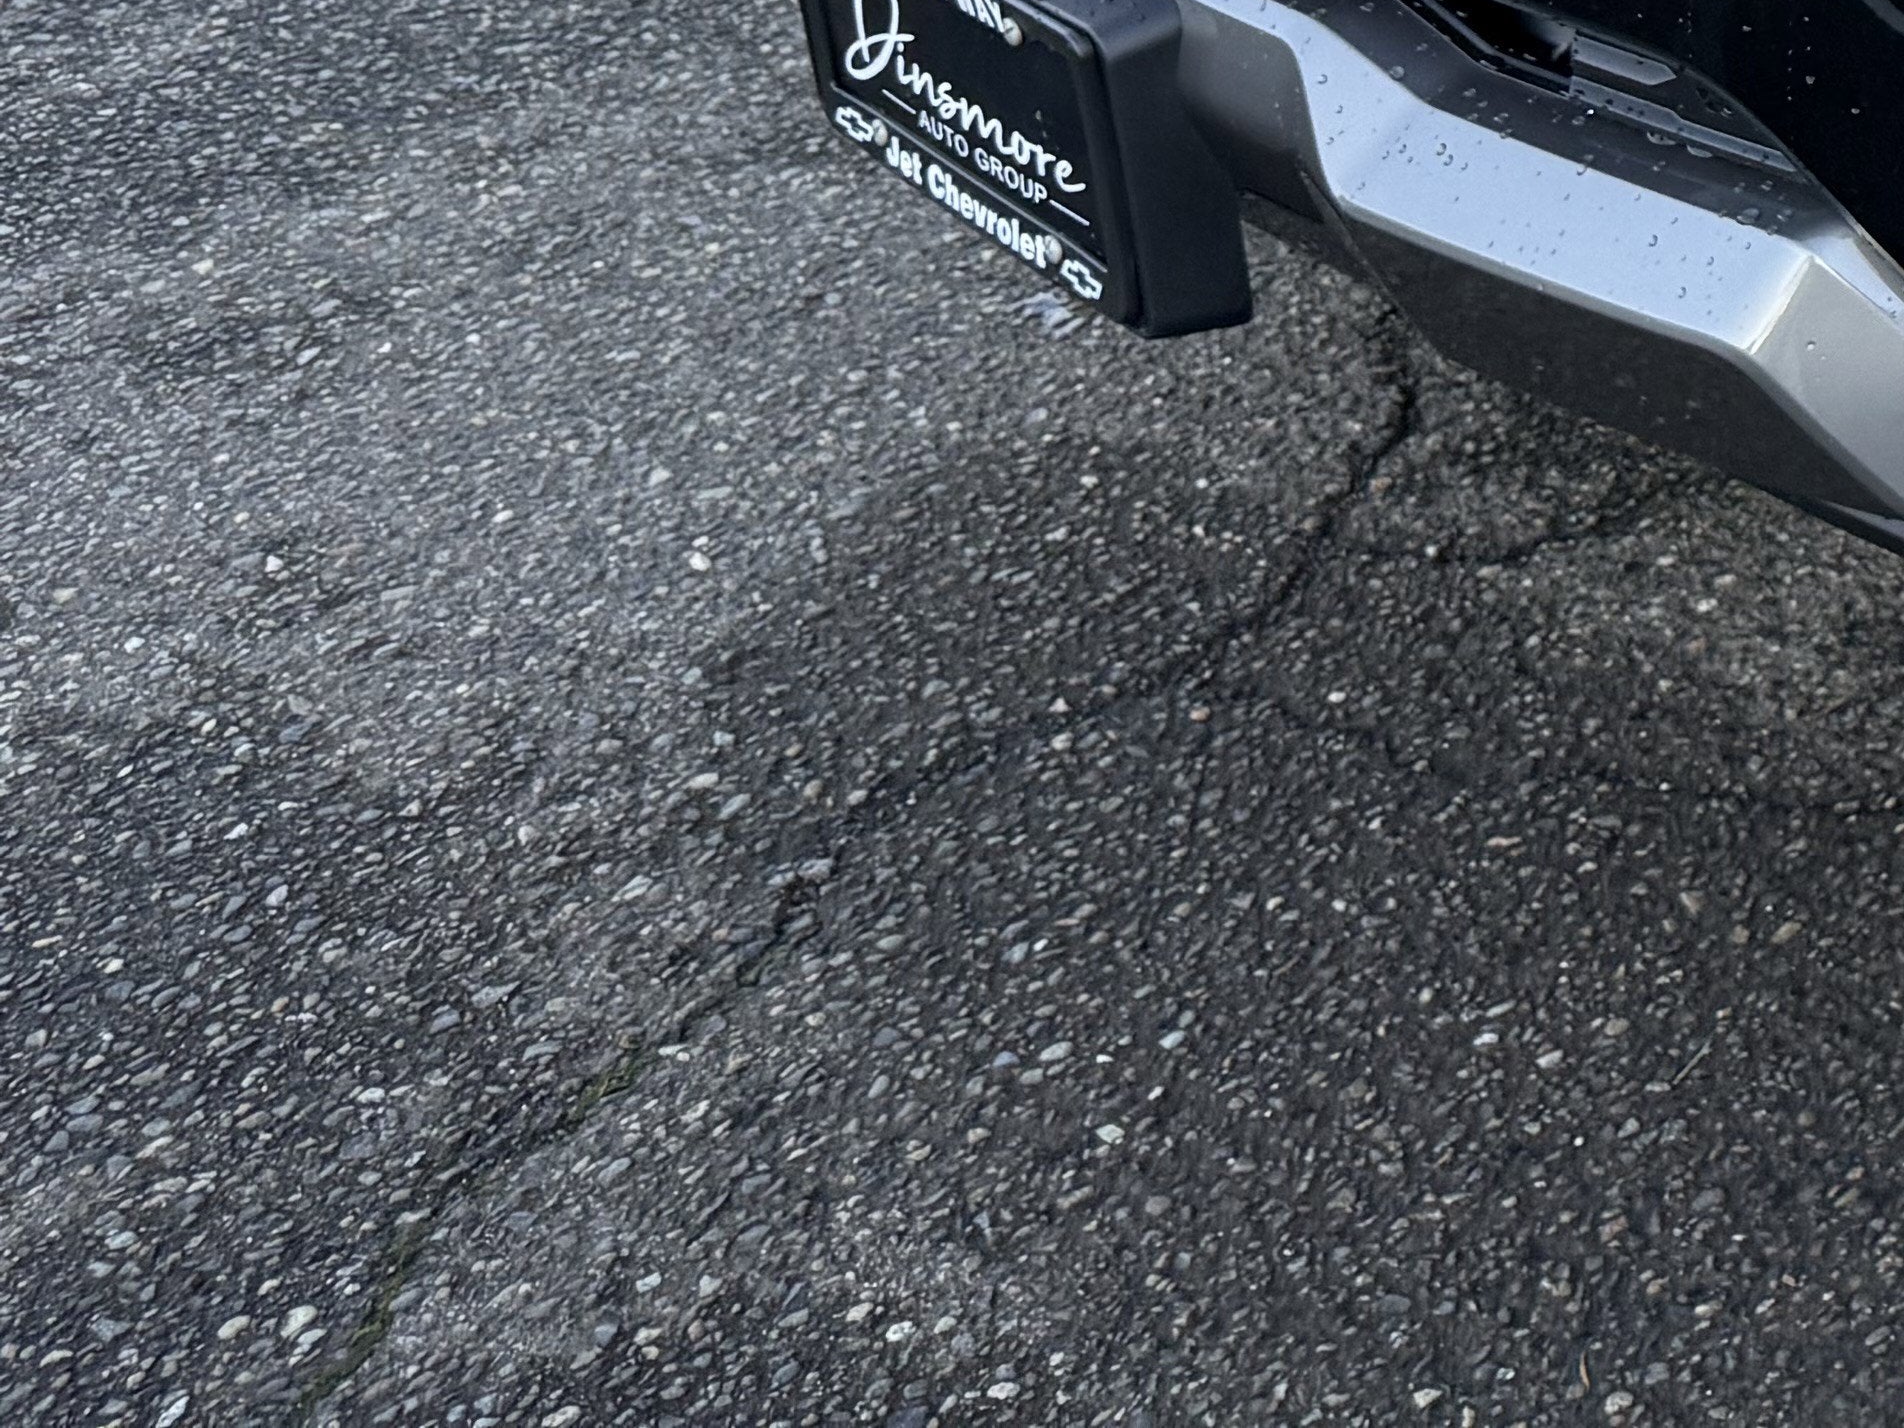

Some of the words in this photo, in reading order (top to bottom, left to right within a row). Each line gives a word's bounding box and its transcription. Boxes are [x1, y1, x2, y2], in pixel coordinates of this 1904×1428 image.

[885, 136, 923, 186] Jet
[926, 163, 1047, 269] Chevrolet
[918, 109, 969, 158] AUTO
[974, 147, 1049, 204] GROUP
